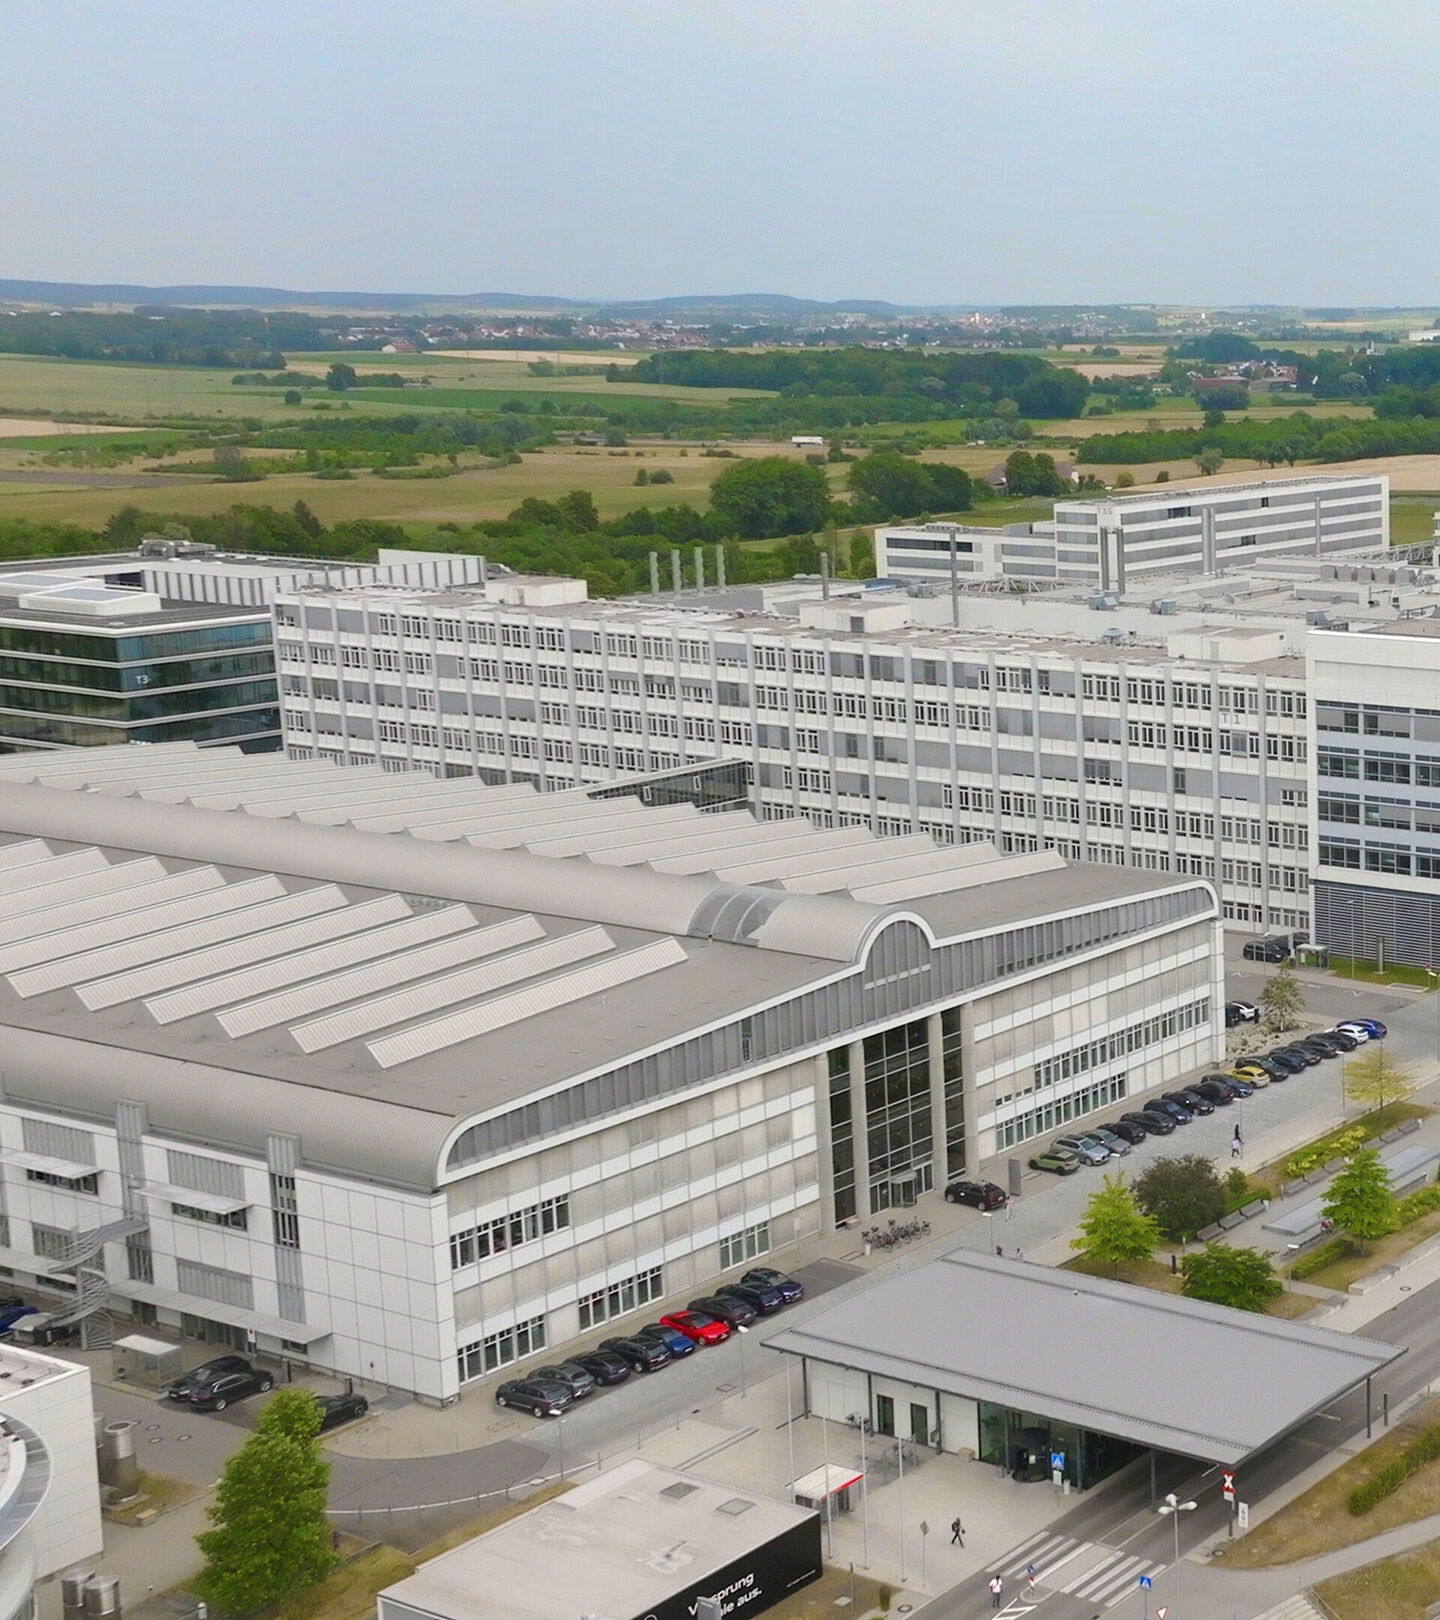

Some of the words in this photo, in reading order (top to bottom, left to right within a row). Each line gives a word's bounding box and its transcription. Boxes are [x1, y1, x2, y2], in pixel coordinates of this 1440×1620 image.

[135, 674, 149, 684] T3
[1221, 712, 1241, 725] T1
[688, 1573, 754, 1616] Vsprung
[737, 1587, 762, 1607] aus.
